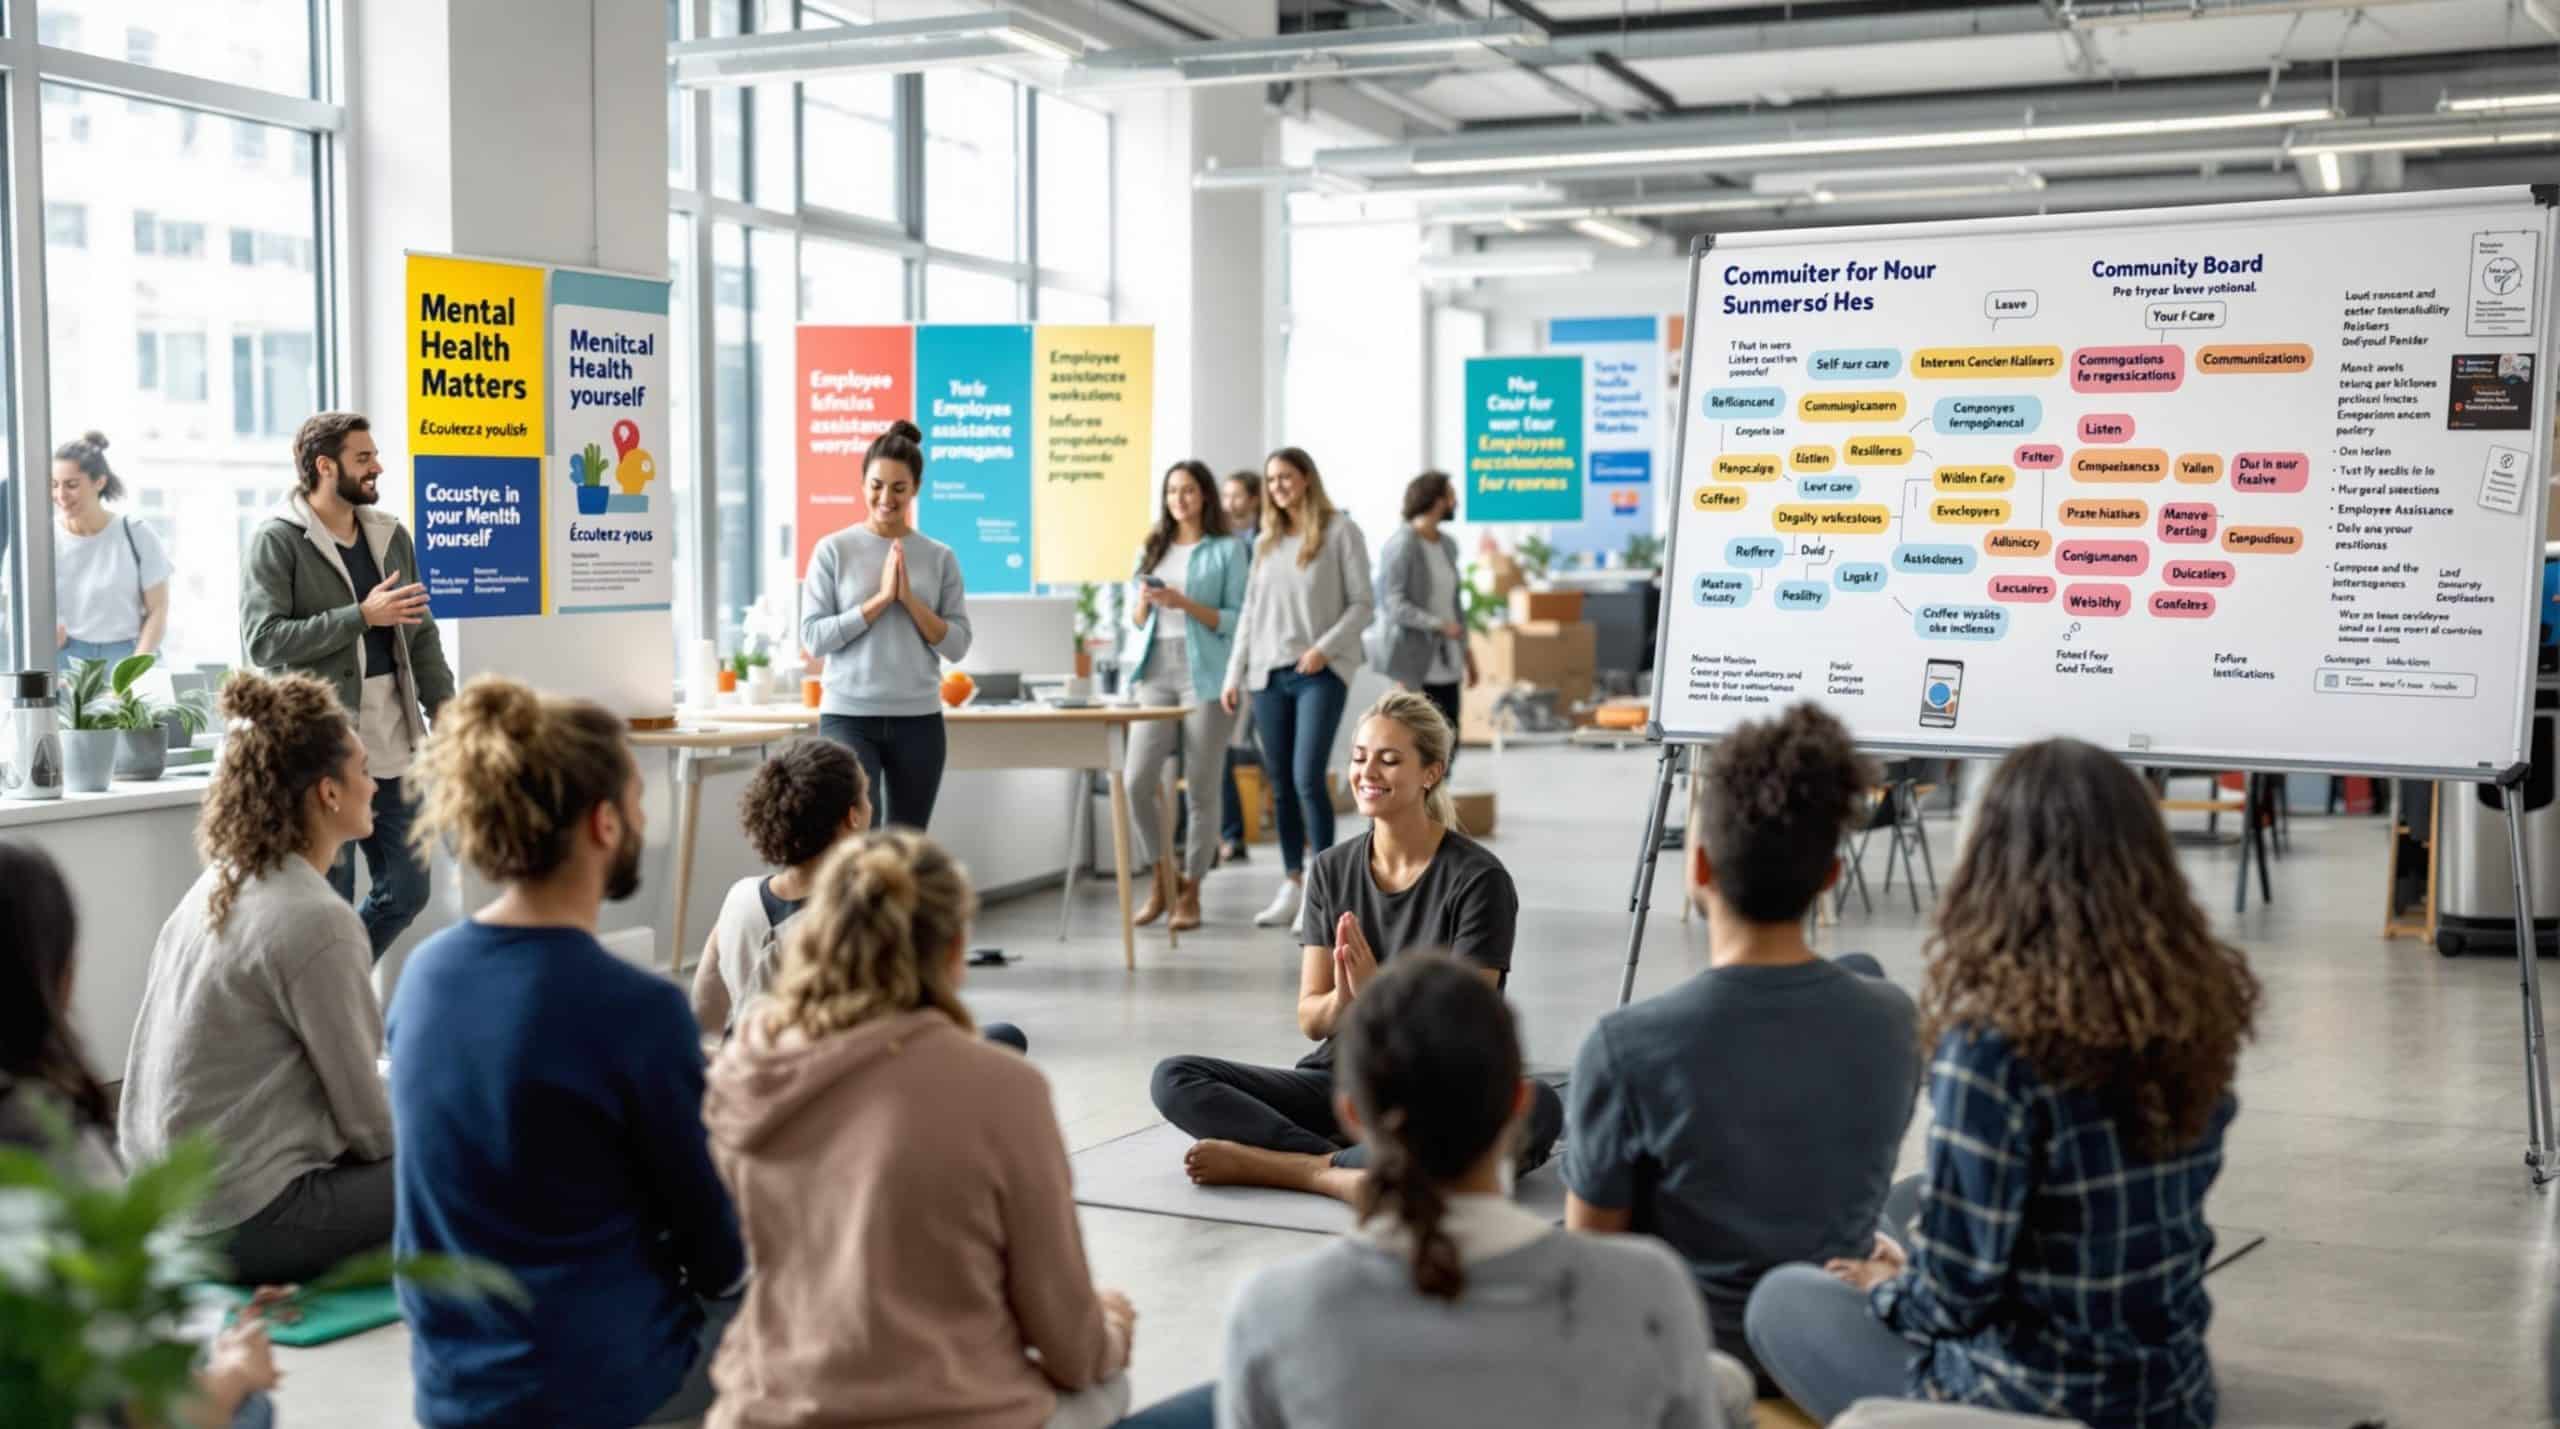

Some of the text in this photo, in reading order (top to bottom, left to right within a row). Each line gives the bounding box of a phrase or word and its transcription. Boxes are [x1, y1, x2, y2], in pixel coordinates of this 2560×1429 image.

[1724, 260, 1936, 285] Commuiter for Nour
[2092, 254, 2263, 278] Community Board
[421, 293, 515, 326] Mental
[1834, 292, 1874, 311] Hes
[2153, 311, 2178, 322] Your
[2190, 311, 2215, 321] Care
[421, 331, 510, 361] Health
[570, 330, 653, 356] Menitcal
[1051, 351, 1120, 365] Employee
[1816, 359, 1839, 370] Self
[1865, 360, 1889, 369] care
[570, 358, 632, 380] Health
[421, 369, 527, 400] Matters
[810, 371, 892, 391] Employee
[570, 386, 645, 409] yourself
[932, 423, 1011, 438] assistance
[505, 486, 519, 502] in
[426, 510, 463, 528] your
[2338, 505, 2391, 516] Employee
[426, 528, 492, 550] yourself
